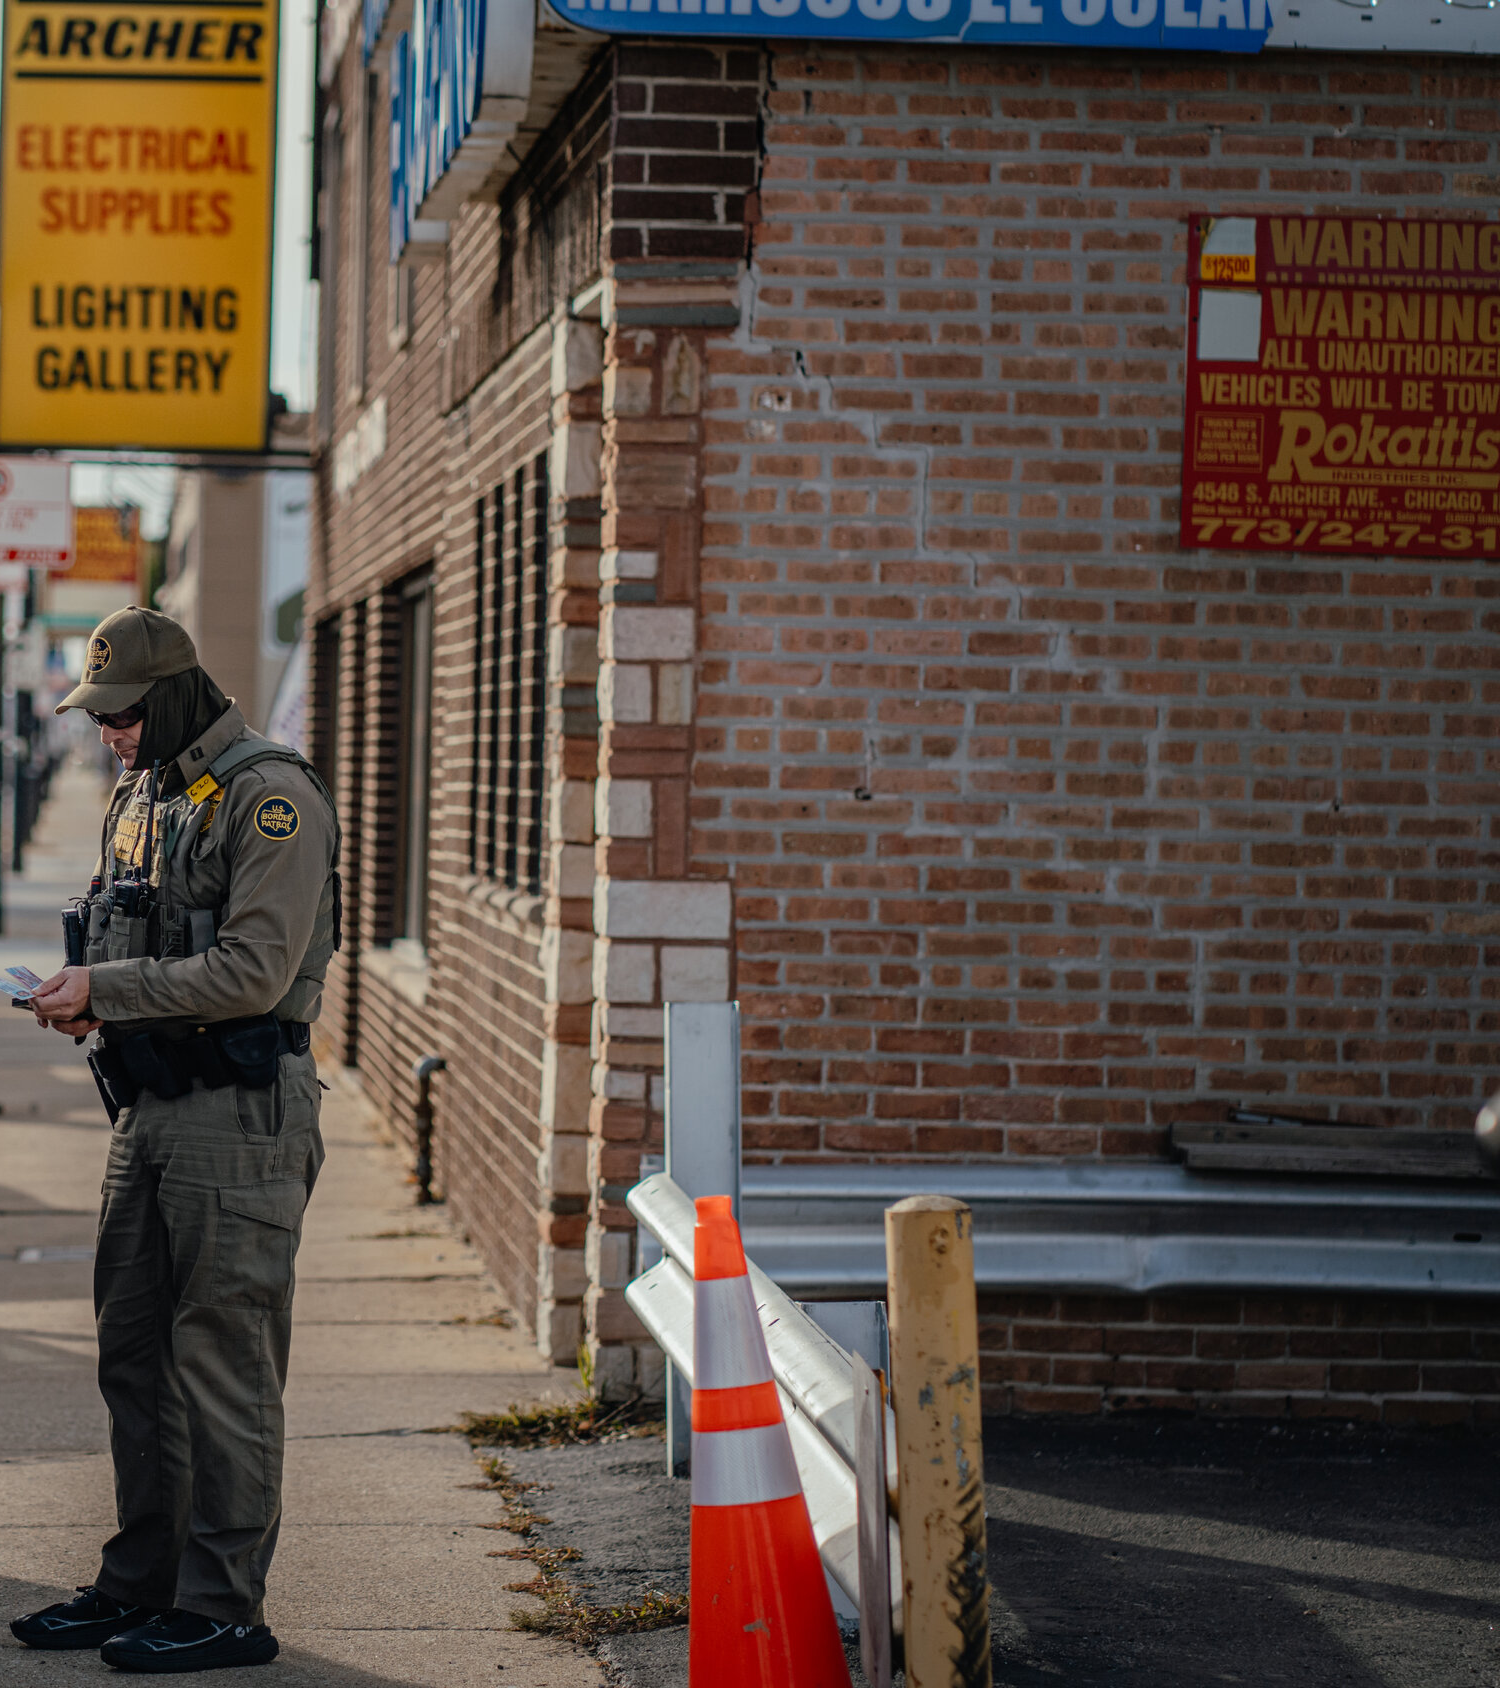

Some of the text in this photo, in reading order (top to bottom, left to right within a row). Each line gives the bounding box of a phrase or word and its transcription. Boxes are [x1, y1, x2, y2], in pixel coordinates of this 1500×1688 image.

[16, 16, 263, 62] ARCHER
[16, 123, 256, 176] ELECTRICAL
[40, 186, 233, 237] SUPPLIES
[1269, 218, 1500, 273] WARNING
[31, 283, 239, 335] LIGHTING
[1269, 288, 1500, 344] WARNING
[35, 346, 231, 394] GALLERY
[1262, 338, 1500, 377] ALL UNAUTHORIZE
[1199, 373, 1321, 408] VEHICLES
[1330, 377, 1393, 410] WILL
[1401, 380, 1434, 413] BE
[1267, 409, 1500, 483] Rokaitis
[1246, 483, 1262, 504] S.
[1269, 484, 1341, 506] ARCHER
[1346, 487, 1384, 508] AVE.
[1404, 488, 1486, 512] CHICAGO,
[1332, 470, 1430, 484] INDUSTRIES
[261, 820, 292, 830] PATROL
[262, 812, 292, 822] BORDER
